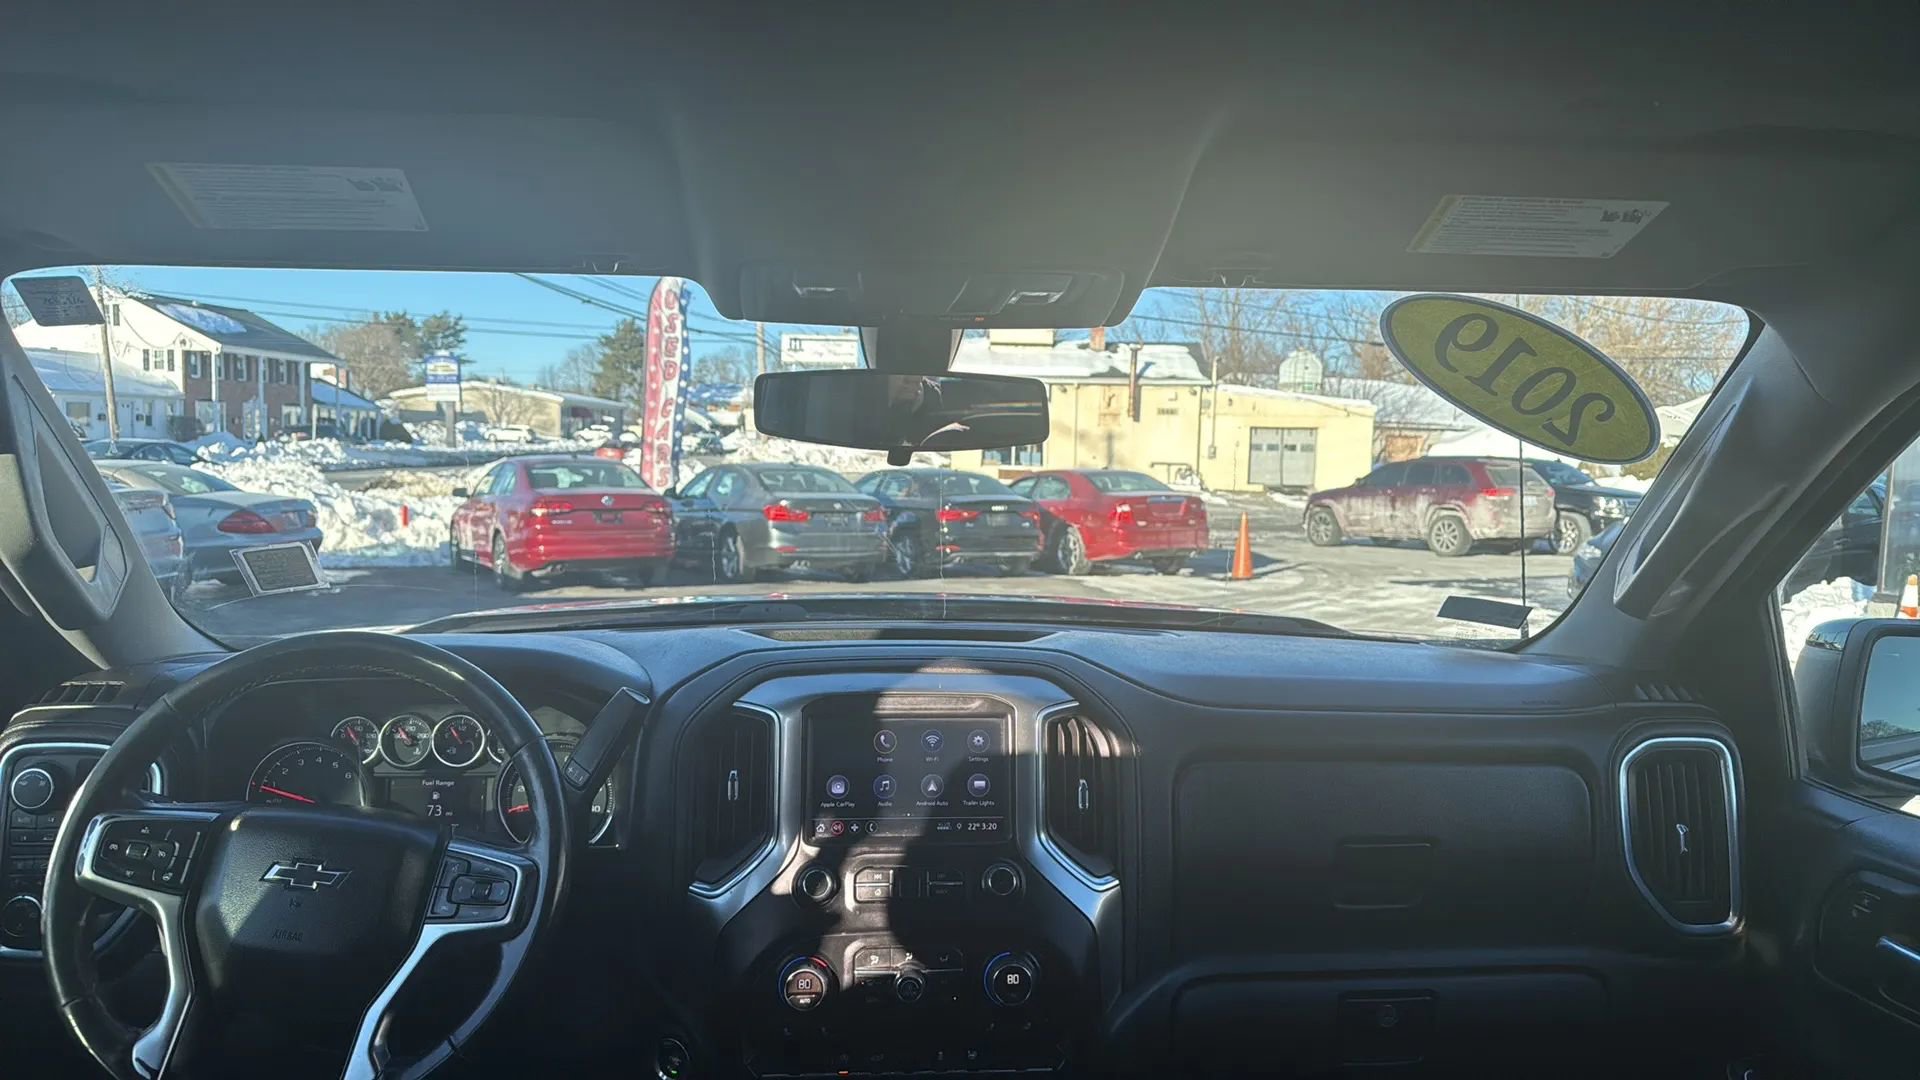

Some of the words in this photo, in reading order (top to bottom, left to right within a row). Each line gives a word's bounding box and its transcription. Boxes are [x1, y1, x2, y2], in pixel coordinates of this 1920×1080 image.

[663, 288, 680, 381] USED
[655, 397, 674, 488] CARS
[315, 756, 323, 764] 4
[281, 767, 289, 775] 2
[436, 779, 455, 787] Range
[979, 800, 995, 808] Lights
[426, 804, 442, 817] 73
[981, 822, 998, 830] 3:20
[1007, 974, 1020, 985] 80
[798, 979, 811, 990] 80
